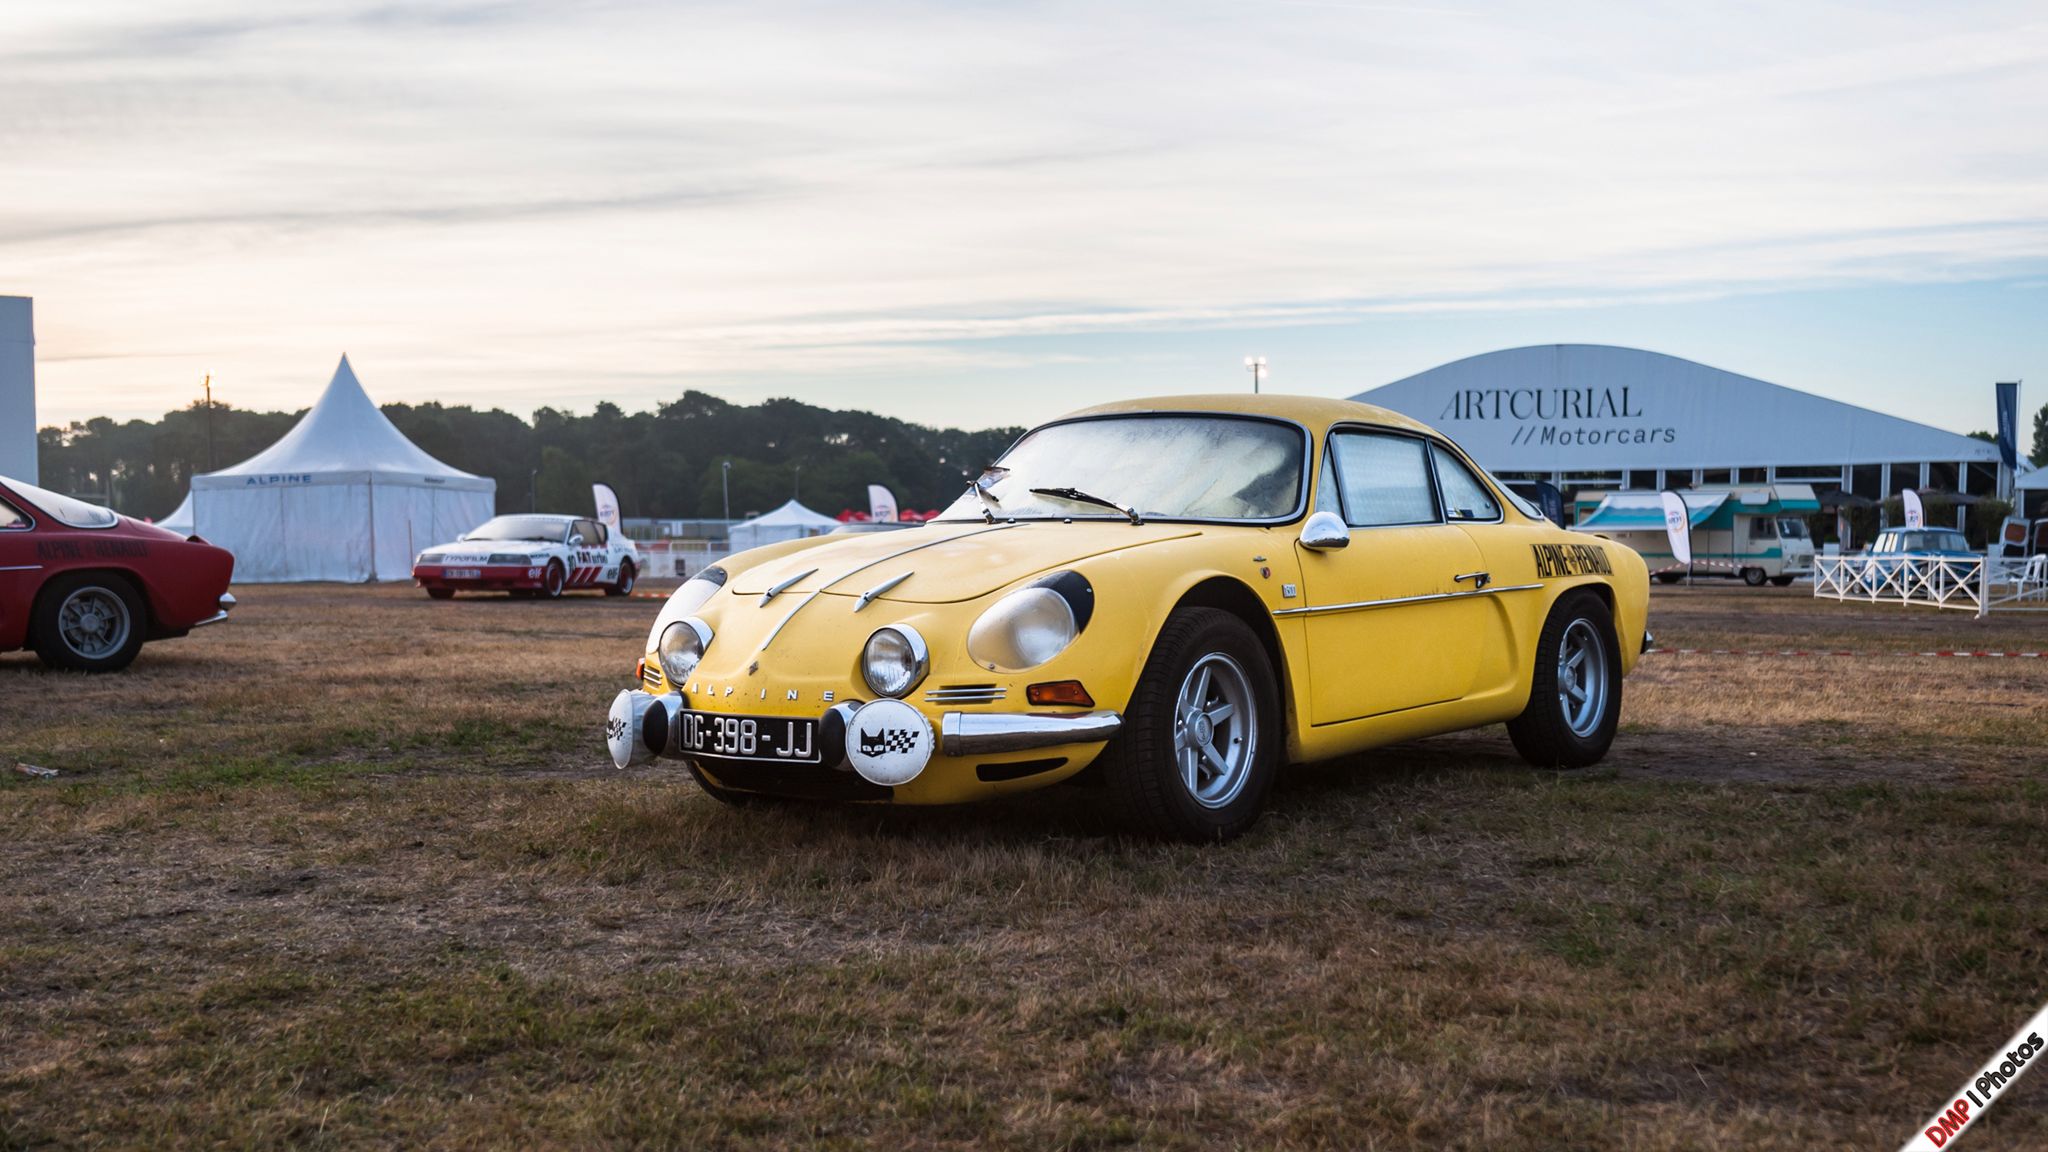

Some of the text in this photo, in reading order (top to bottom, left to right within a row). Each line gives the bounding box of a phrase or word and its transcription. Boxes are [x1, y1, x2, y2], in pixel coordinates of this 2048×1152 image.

[1440, 386, 1643, 420] ARTCURIAL
[246, 474, 313, 485] ALPINE
[1533, 544, 1571, 576] ALPINE
[528, 567, 543, 579] elf
[692, 683, 834, 701] ALPINE
[683, 714, 812, 757] DG-398-JJ
